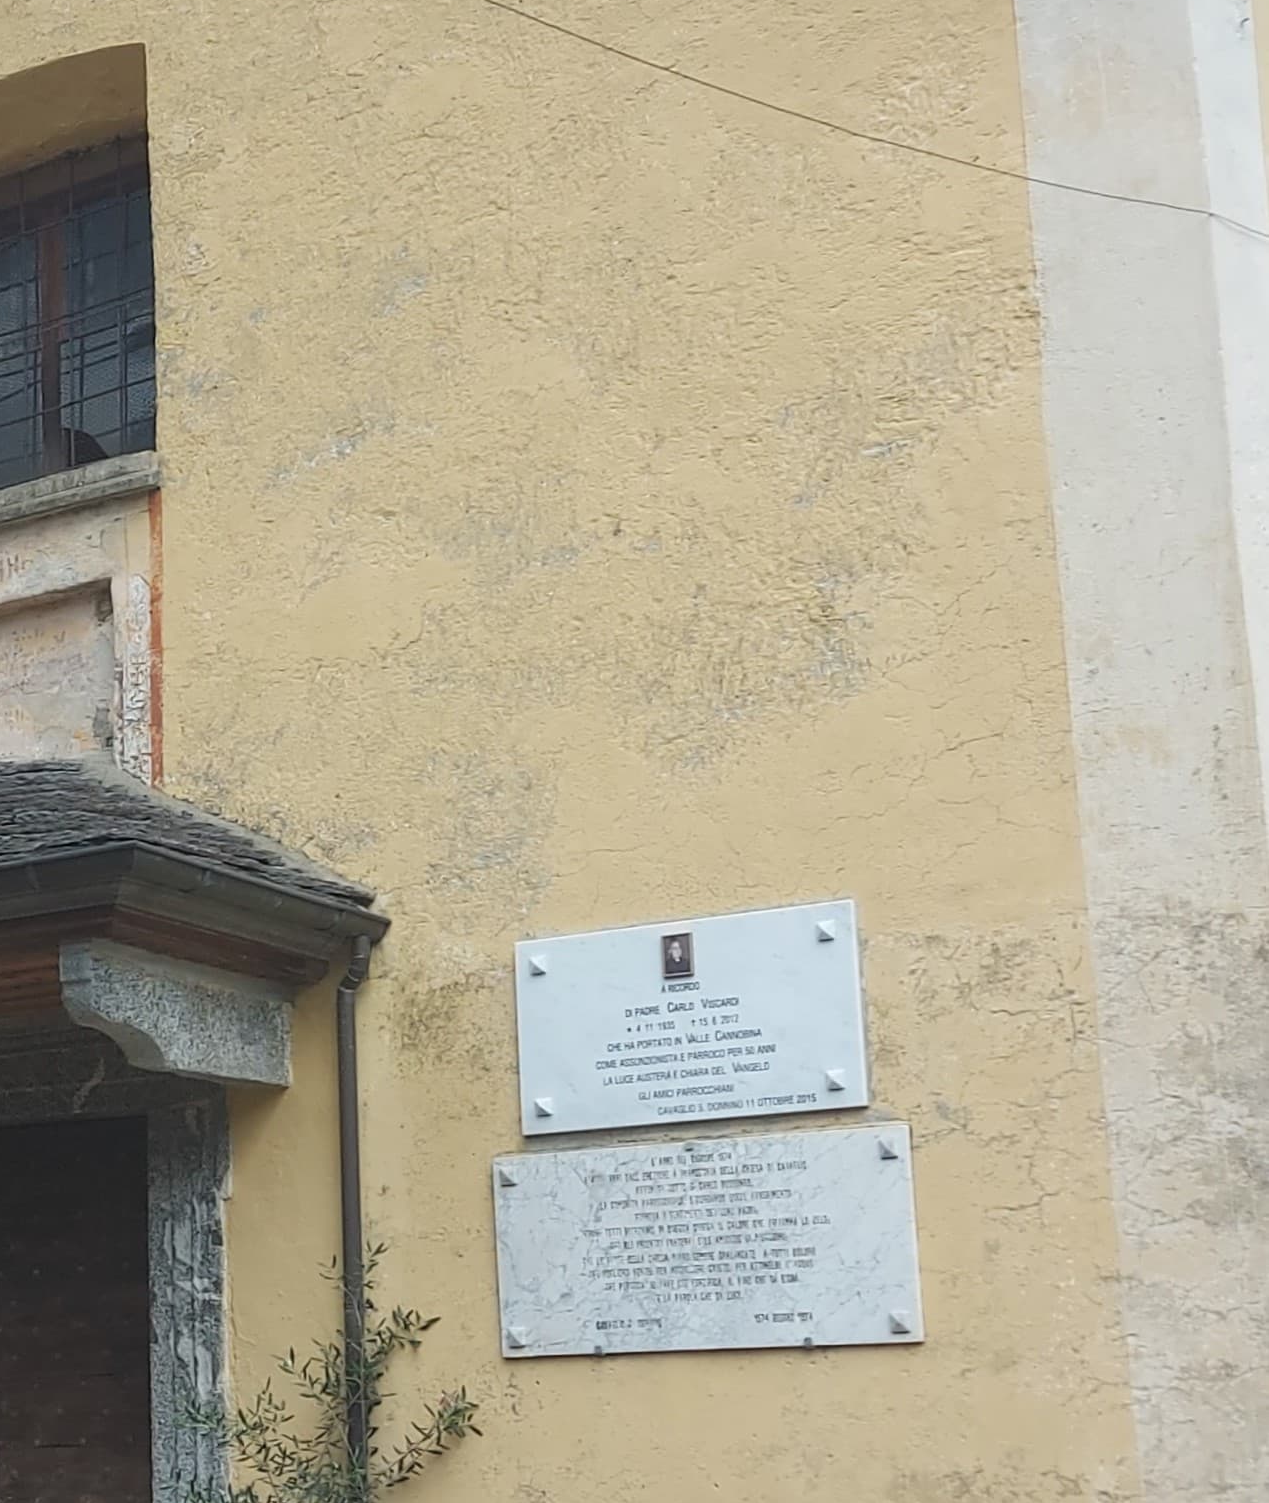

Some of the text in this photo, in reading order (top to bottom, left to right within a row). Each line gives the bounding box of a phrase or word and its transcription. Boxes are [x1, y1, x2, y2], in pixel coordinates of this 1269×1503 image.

[667, 981, 700, 993] RICORDO
[634, 1005, 660, 1016] PADRE
[667, 999, 694, 1013] CARLO
[607, 1042, 621, 1052] CHE
[636, 1037, 672, 1049] PORTATO
[685, 1030, 710, 1044] VALLE
[714, 1025, 762, 1041] CANNOBINA
[595, 1059, 617, 1069] COME
[687, 1048, 725, 1060] PARROCO
[603, 1076, 612, 1085] LA
[614, 1074, 634, 1084] LUCE
[680, 1067, 709, 1078] CHIARA
[731, 1058, 769, 1073] VANGELO
[757, 1095, 793, 1106] OTTOBRE
